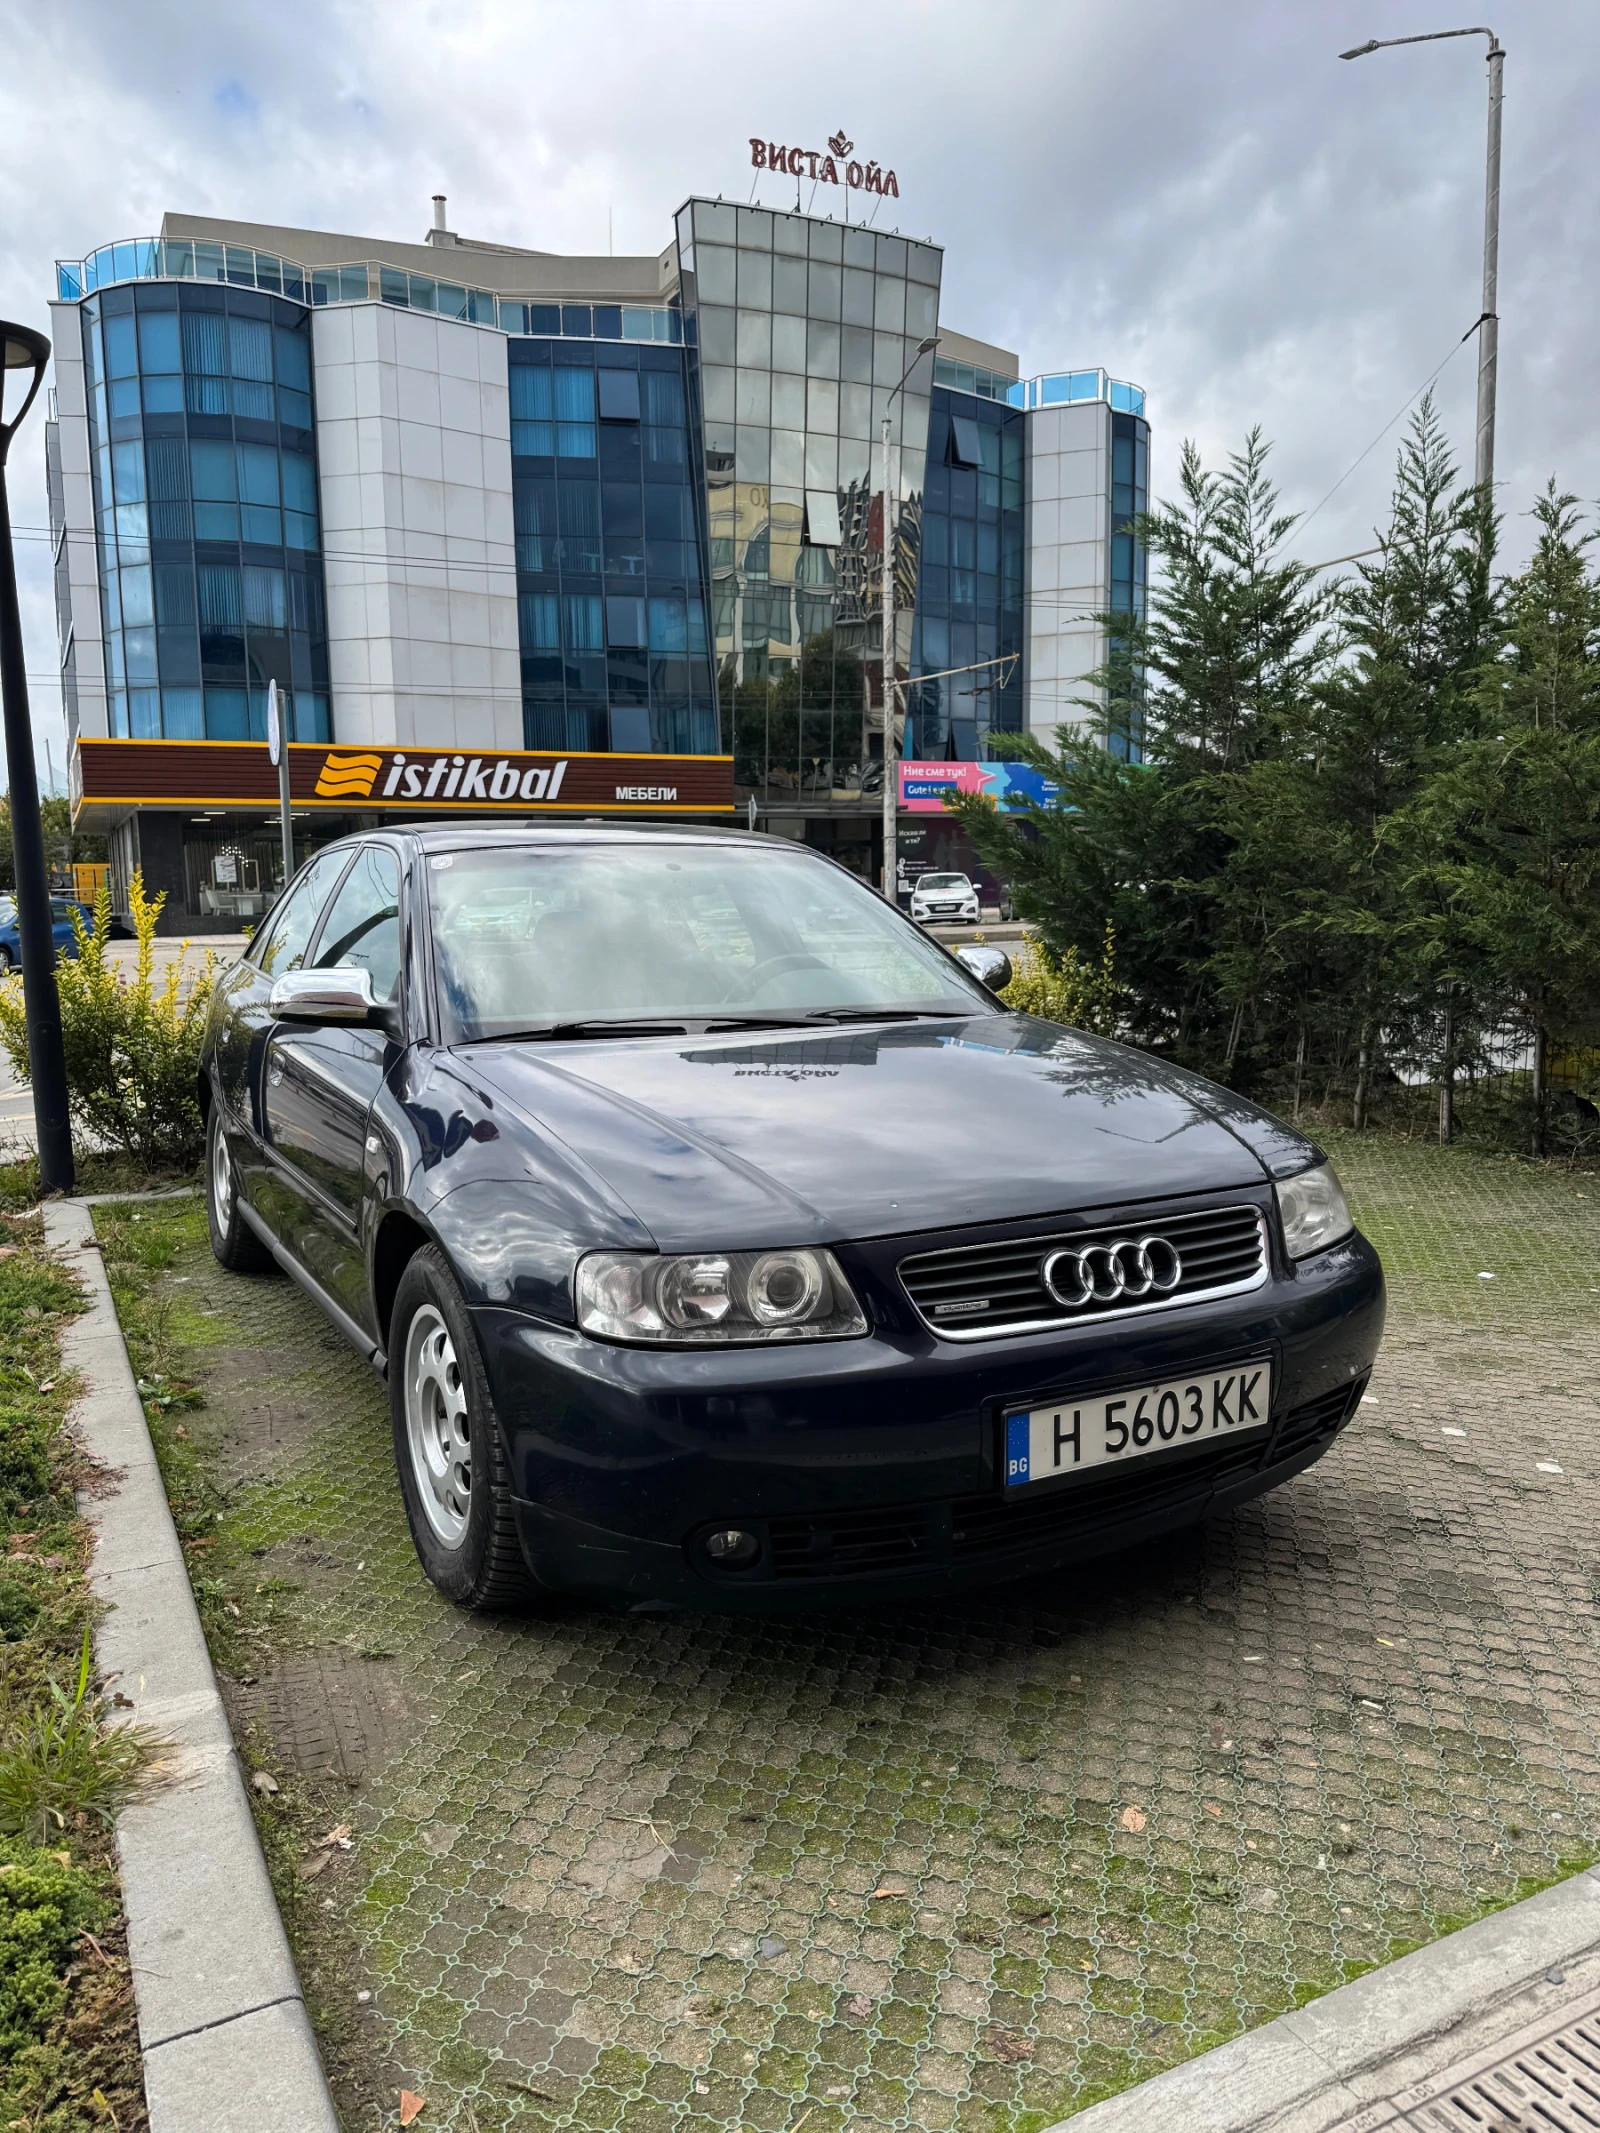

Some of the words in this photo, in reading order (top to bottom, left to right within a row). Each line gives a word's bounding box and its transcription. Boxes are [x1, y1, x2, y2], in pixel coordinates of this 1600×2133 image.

[749, 138, 839, 185] ВИСТА
[847, 160, 899, 198] ОЙЛ
[382, 753, 568, 800] istikbal
[904, 766, 924, 776] Ние
[926, 768, 945, 776] сме
[946, 767, 966, 778] тук!
[616, 786, 677, 801] МЕБЕЛИ
[908, 785, 927, 794] Gute
[1053, 1410, 1081, 1467] H
[1009, 1457, 1028, 1476] BG
